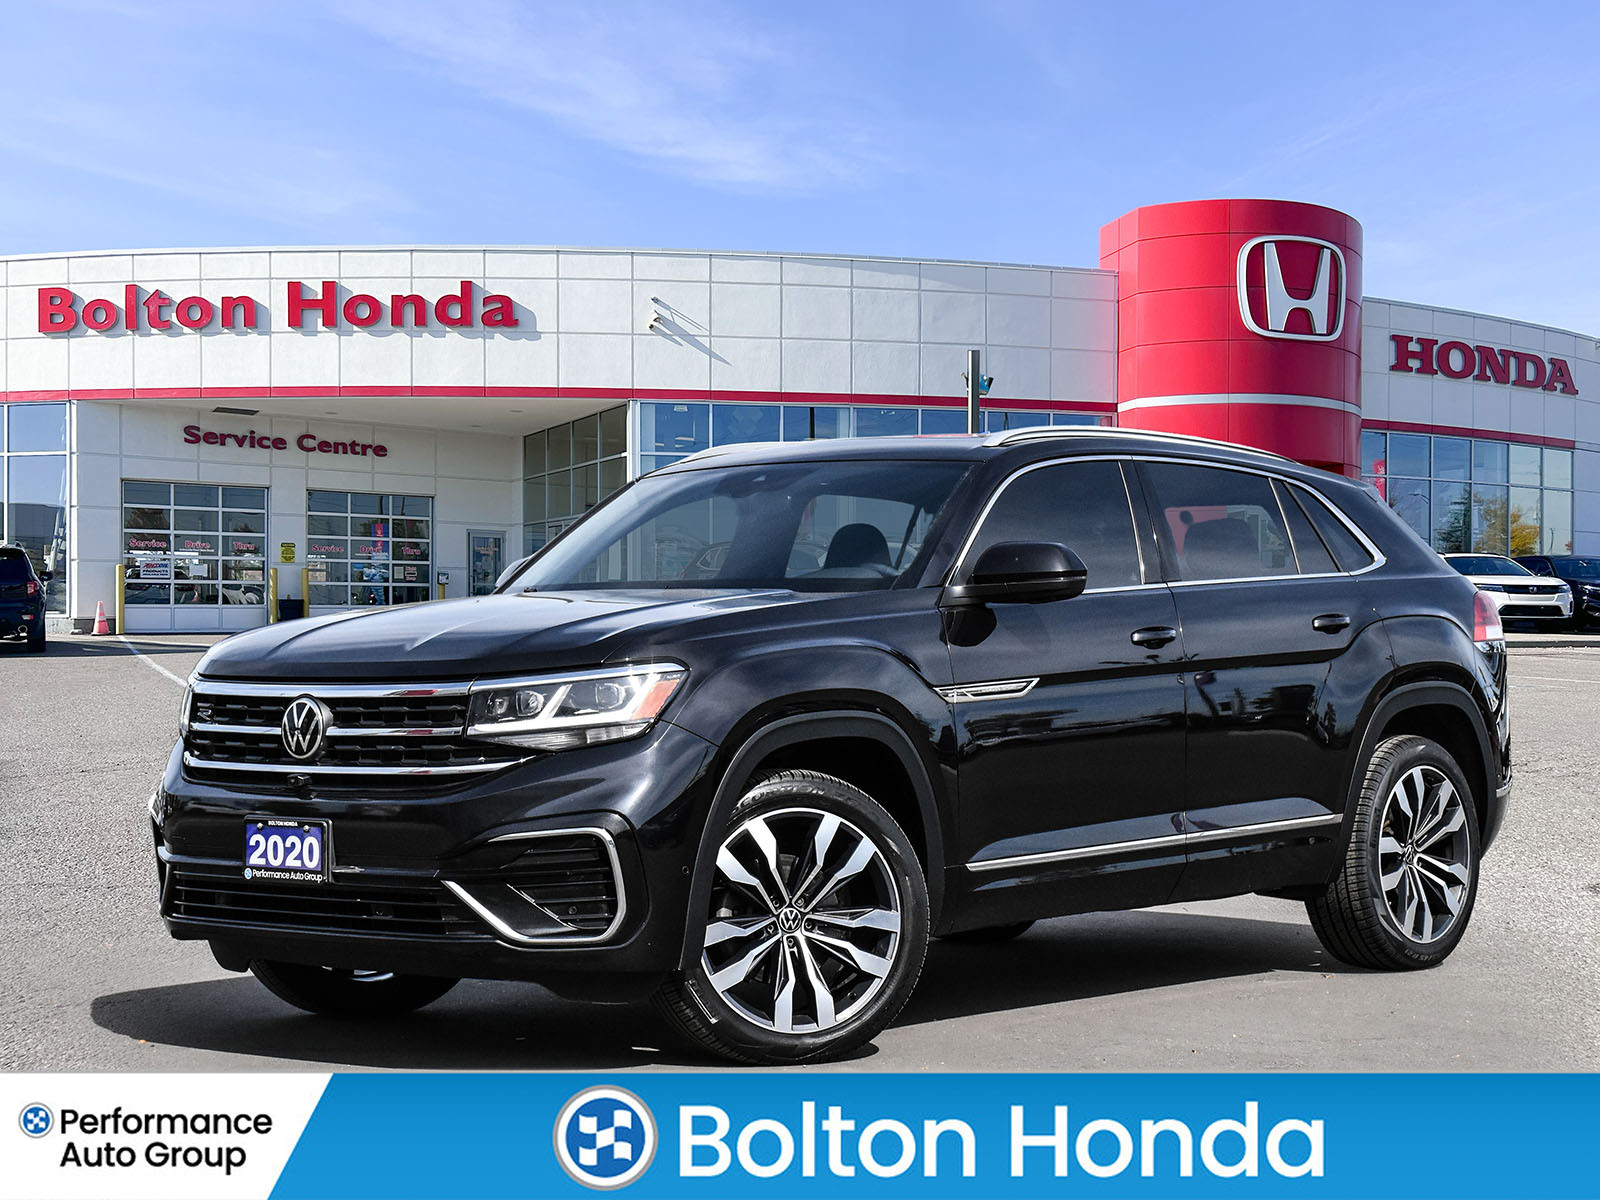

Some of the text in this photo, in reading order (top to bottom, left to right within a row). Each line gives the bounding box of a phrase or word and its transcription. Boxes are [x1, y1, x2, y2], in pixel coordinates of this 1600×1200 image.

[37, 280, 520, 333] Bolton Honda
[1389, 333, 1579, 395] HONDA
[183, 424, 389, 457] Service Centre
[129, 538, 255, 551] Service Drive Thru
[312, 543, 344, 552] Service
[248, 833, 320, 869] 2020
[252, 869, 323, 883] Performance Auto Group
